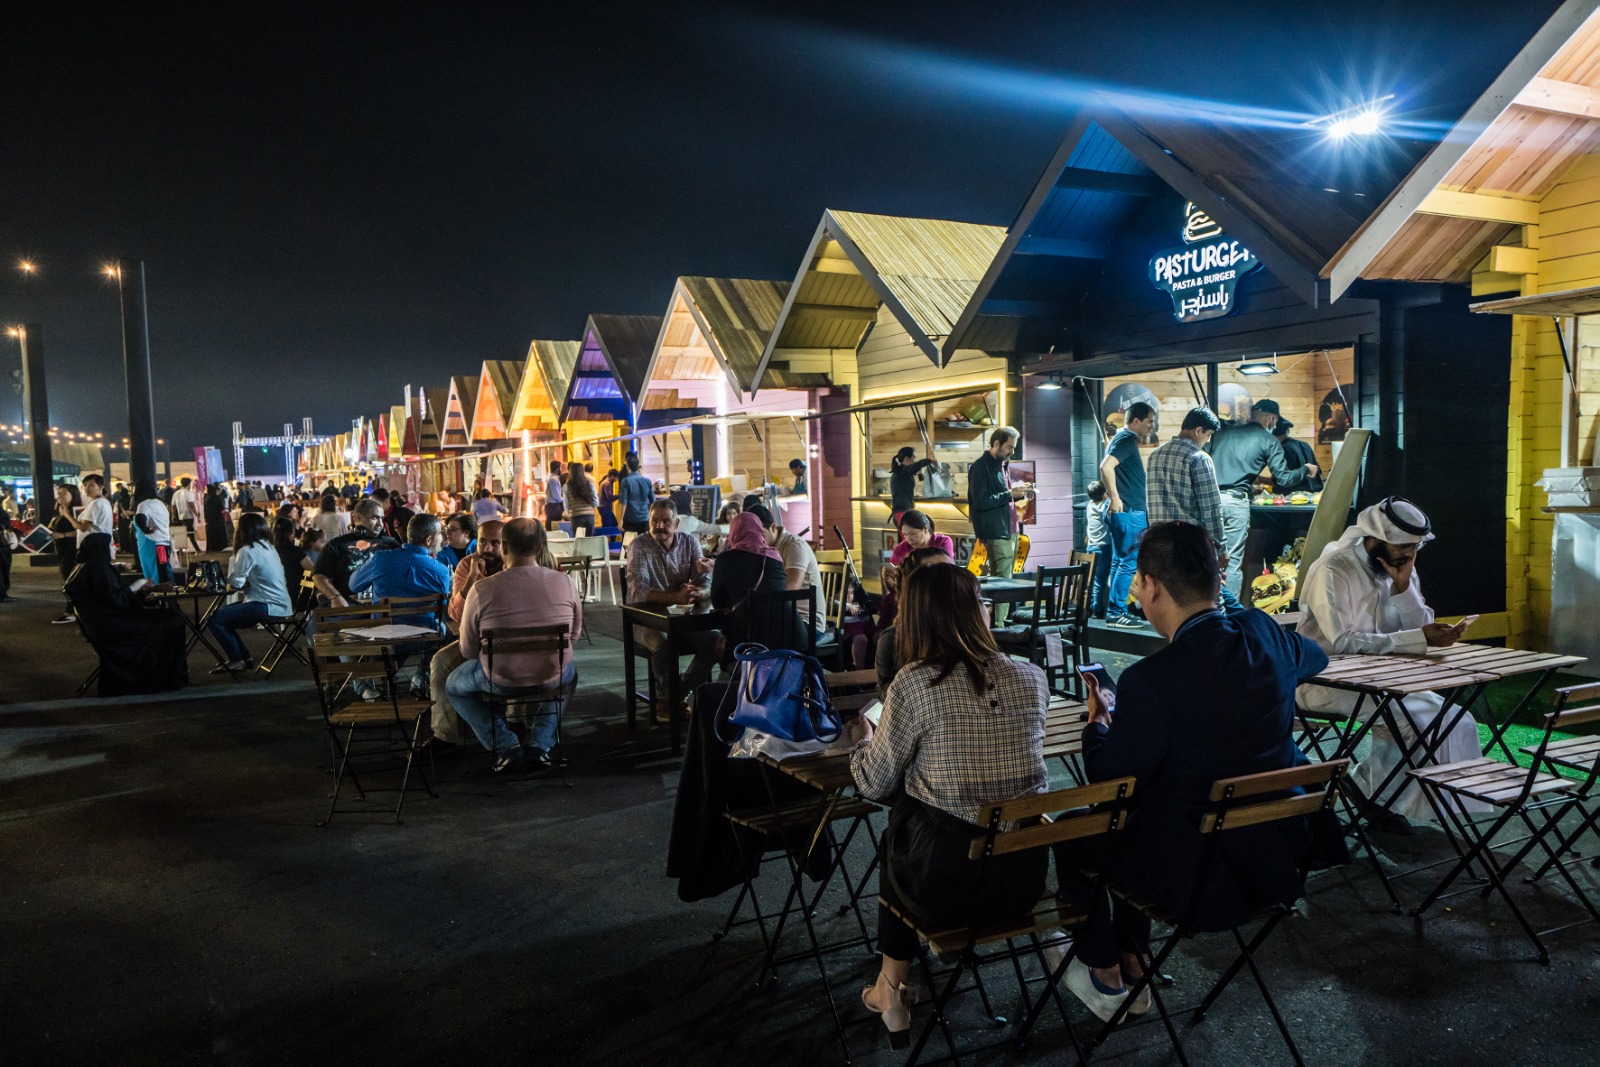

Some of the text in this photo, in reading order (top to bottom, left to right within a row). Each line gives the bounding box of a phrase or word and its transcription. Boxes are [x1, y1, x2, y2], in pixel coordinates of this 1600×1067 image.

[1172, 270, 1236, 291] PASTA & BURGER
